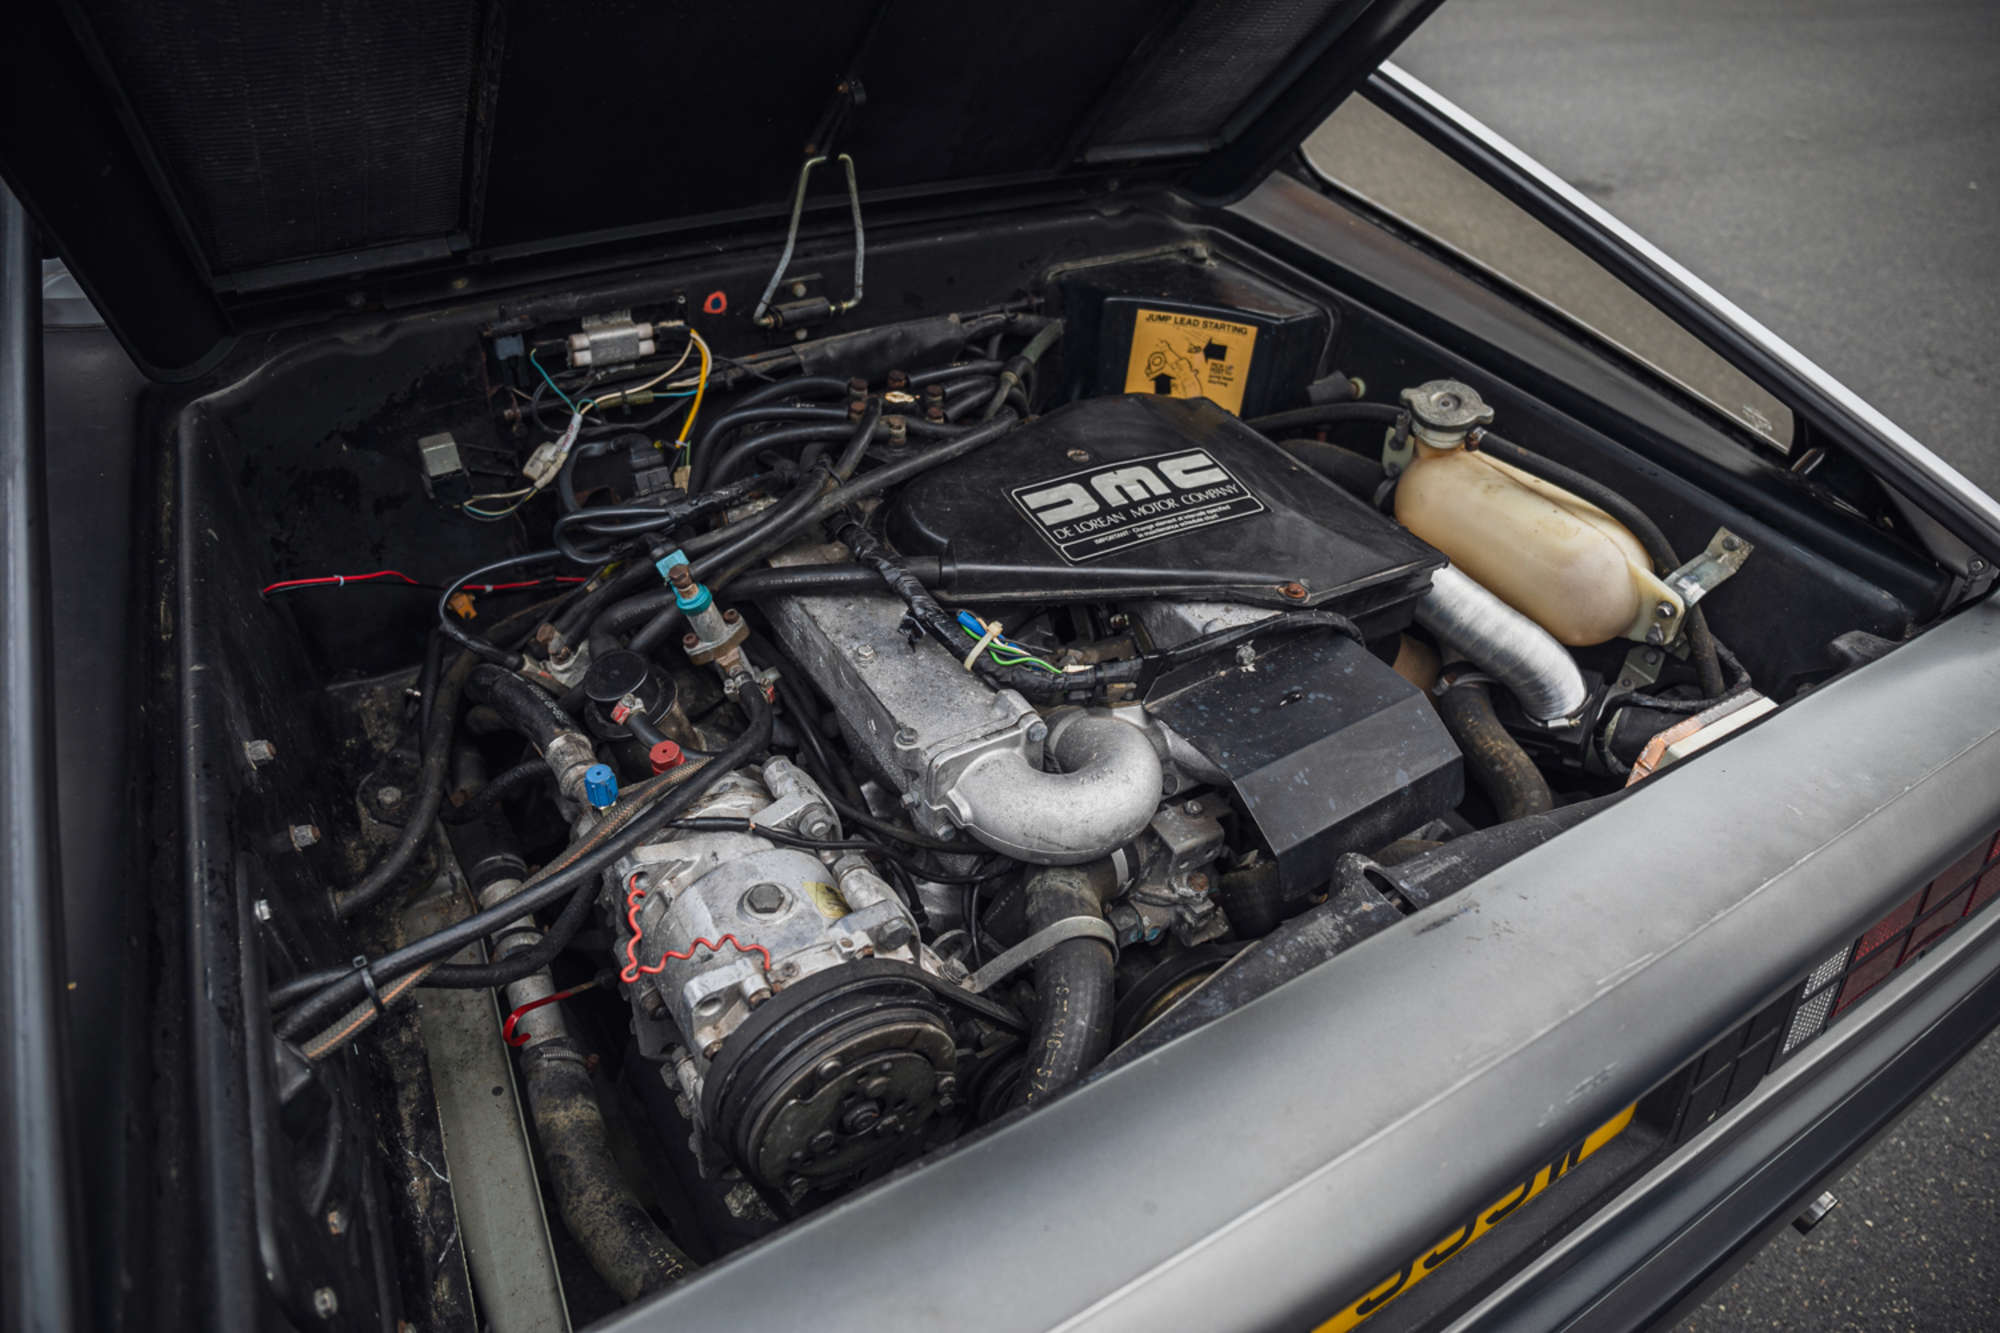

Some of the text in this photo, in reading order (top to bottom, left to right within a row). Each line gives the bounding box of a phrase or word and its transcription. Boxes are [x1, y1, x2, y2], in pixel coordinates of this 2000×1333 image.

[1145, 313, 1248, 335] JUMP LEAD STARTING
[1053, 484, 1239, 539] DE LOREAN MOTOR COMPANY
